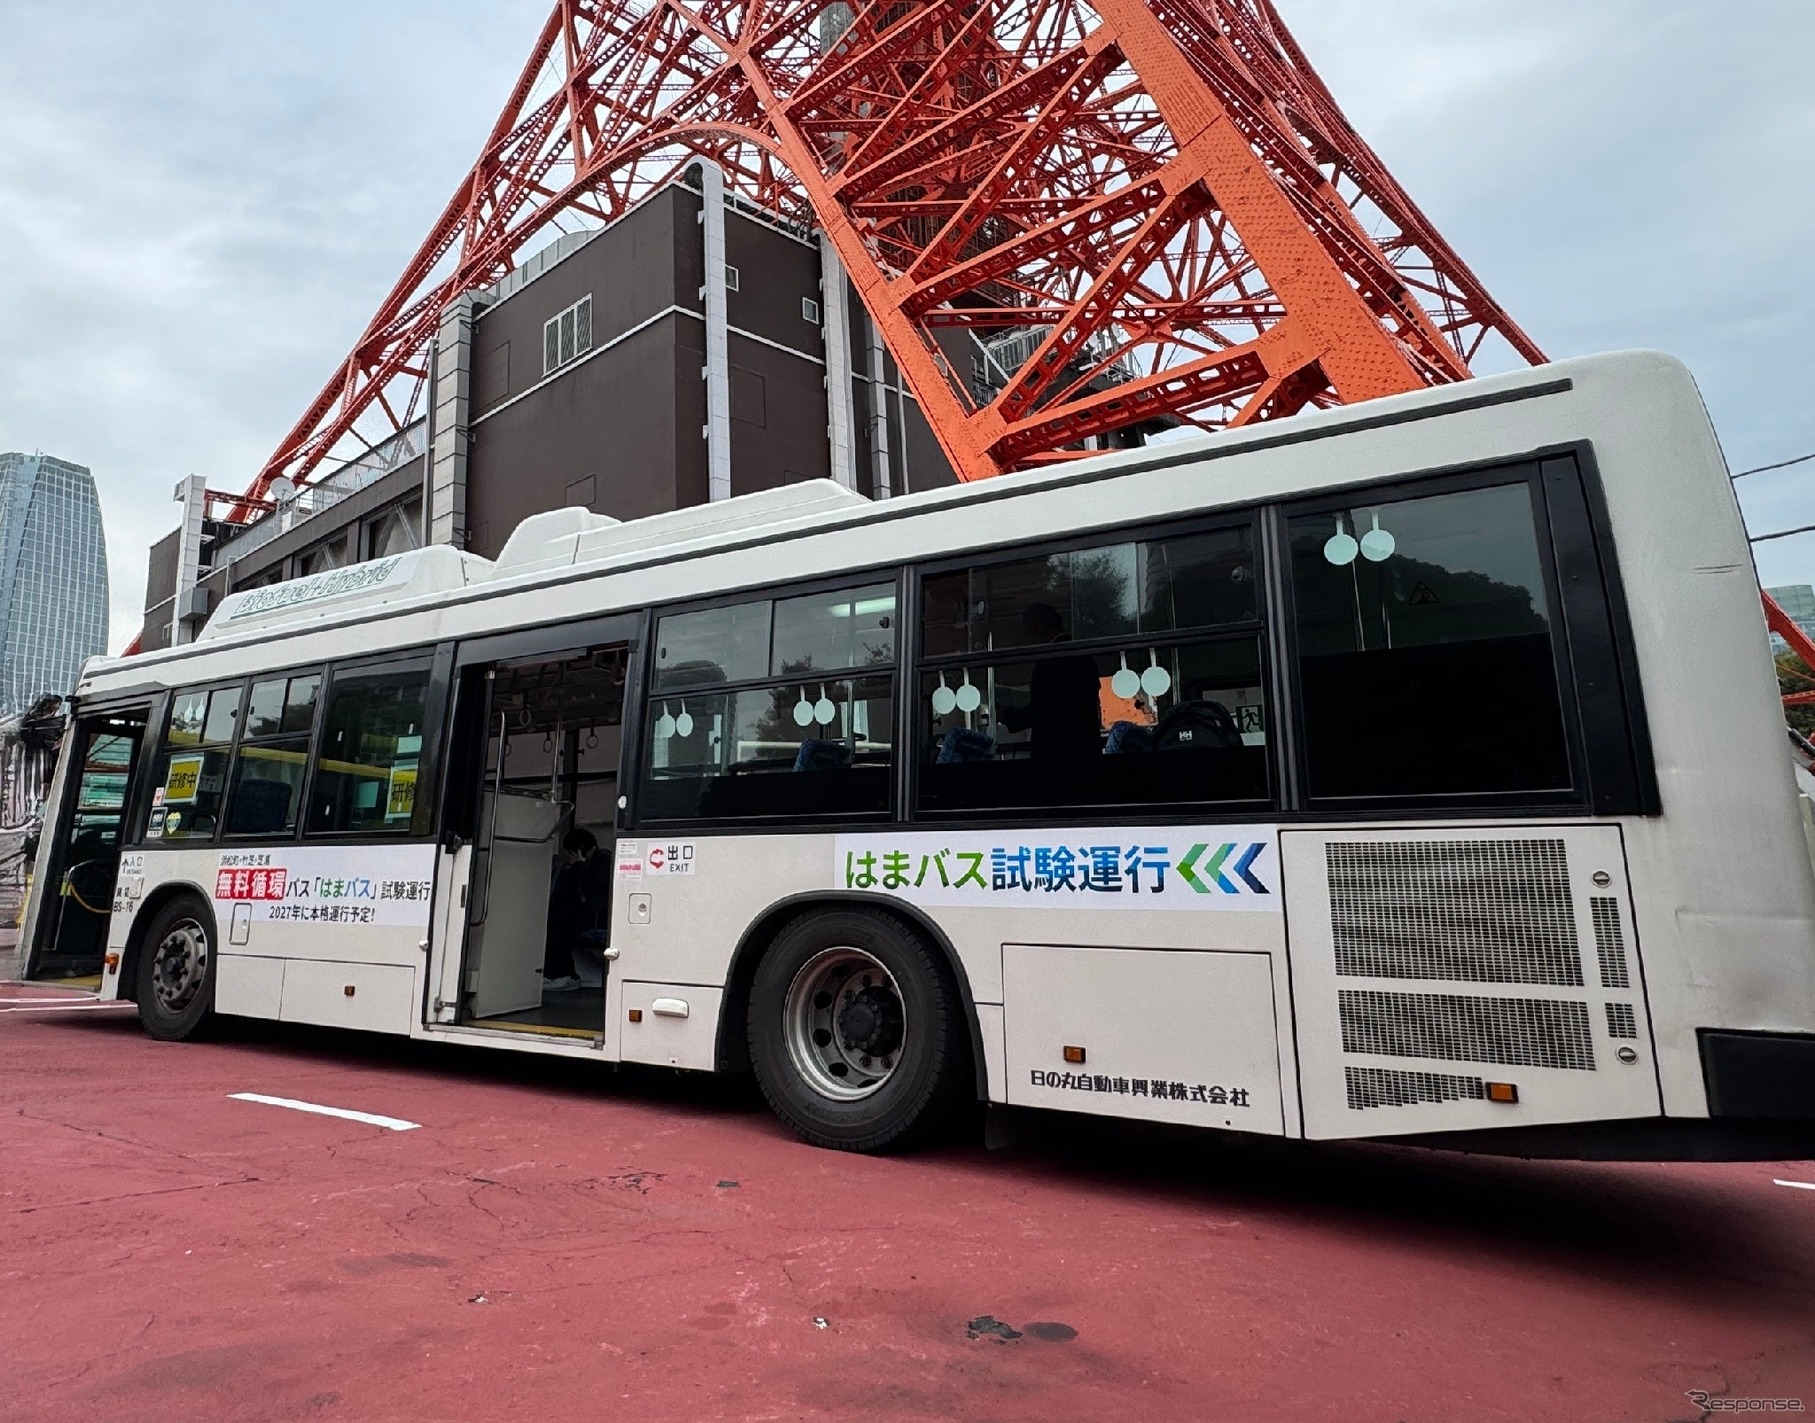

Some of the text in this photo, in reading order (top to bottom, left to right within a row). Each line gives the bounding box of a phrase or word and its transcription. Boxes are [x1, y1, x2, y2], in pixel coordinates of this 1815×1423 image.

[168, 772, 197, 789] 研修中
[667, 844, 694, 861] 出口
[130, 856, 143, 867] 入口
[670, 862, 690, 874] EXIT
[845, 844, 1171, 894] はまバス試験運行
[1030, 1069, 1251, 1108] 日の丸自動車興業株式会社
